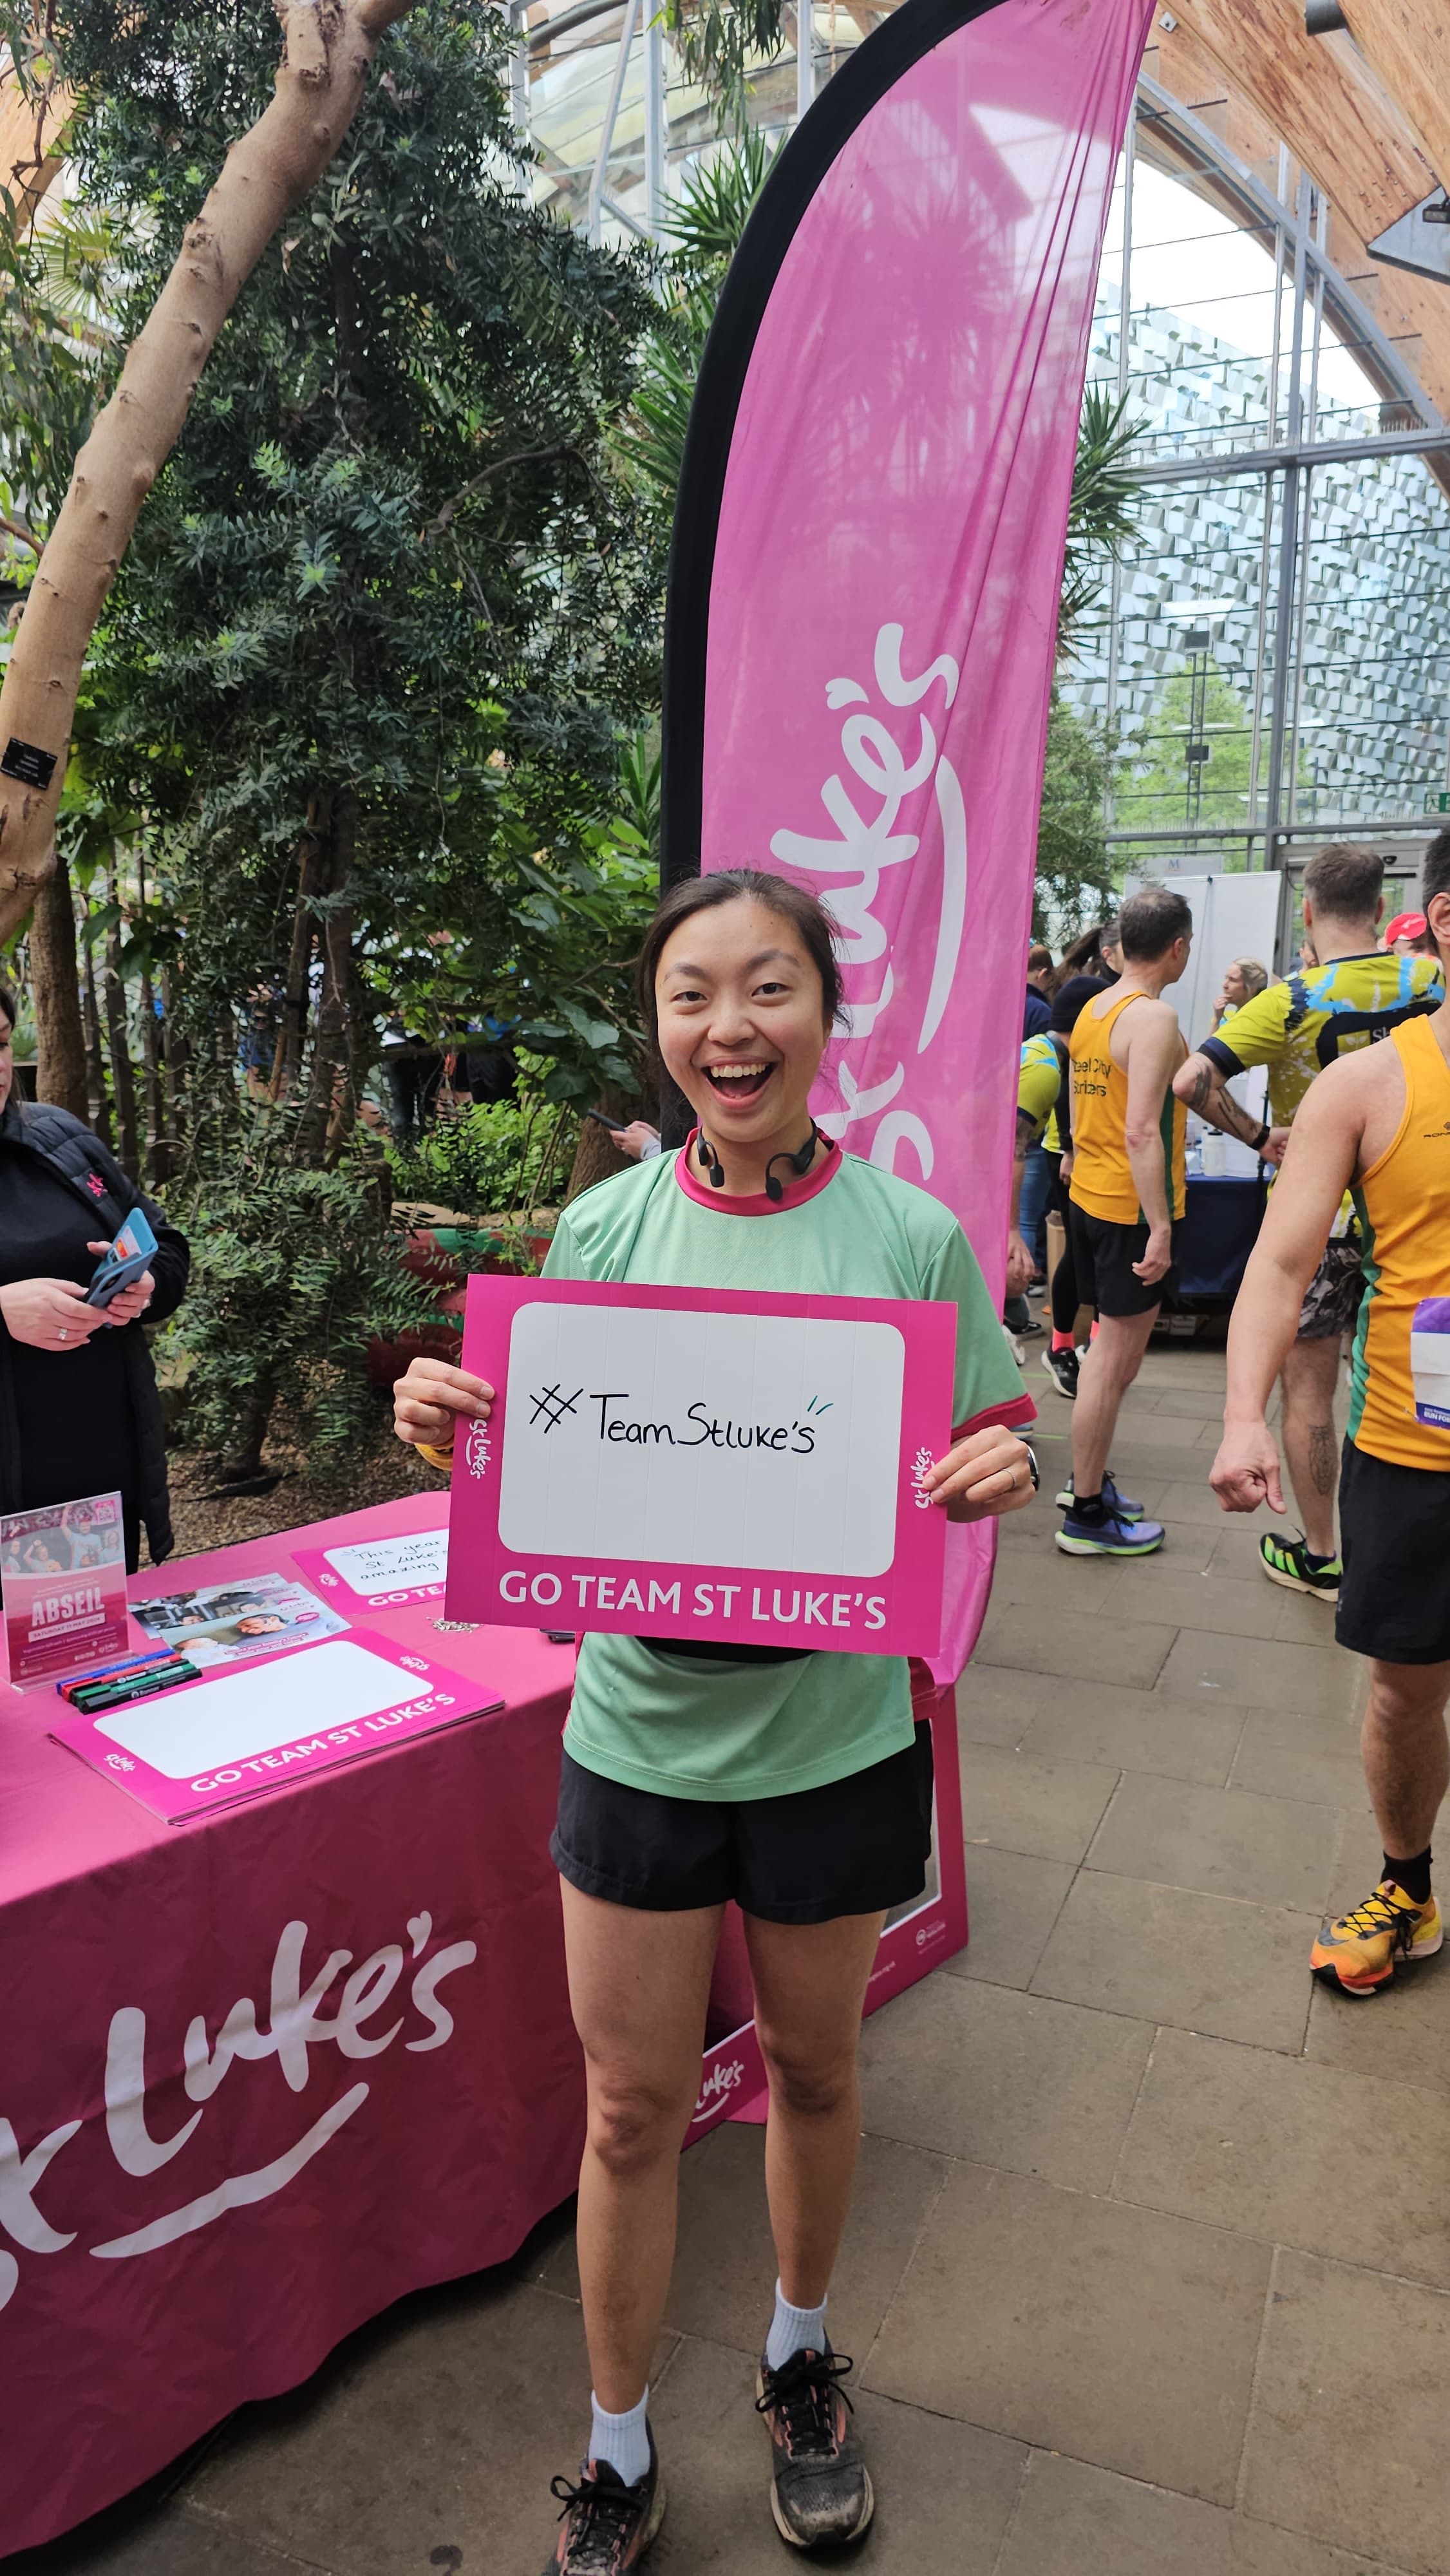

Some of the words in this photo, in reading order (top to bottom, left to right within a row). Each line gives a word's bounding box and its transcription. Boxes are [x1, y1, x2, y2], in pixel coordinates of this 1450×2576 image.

[354, 1549, 393, 1560] This
[404, 1540, 441, 1554] year
[360, 1562, 439, 1579] amazing
[32, 1586, 105, 1627] ABSEIL
[368, 1593, 408, 1606] GO
[499, 1571, 563, 1605] GO
[571, 1575, 681, 1614] TEAM
[693, 1582, 742, 1618] ST
[752, 1588, 887, 1629] LUKE'S
[191, 1769, 242, 1792] GO
[241, 1738, 328, 1773] TEAM
[327, 1725, 363, 1745] ST
[364, 1694, 456, 1732] LUKE'S
[104, 1910, 477, 2177] Luke's
